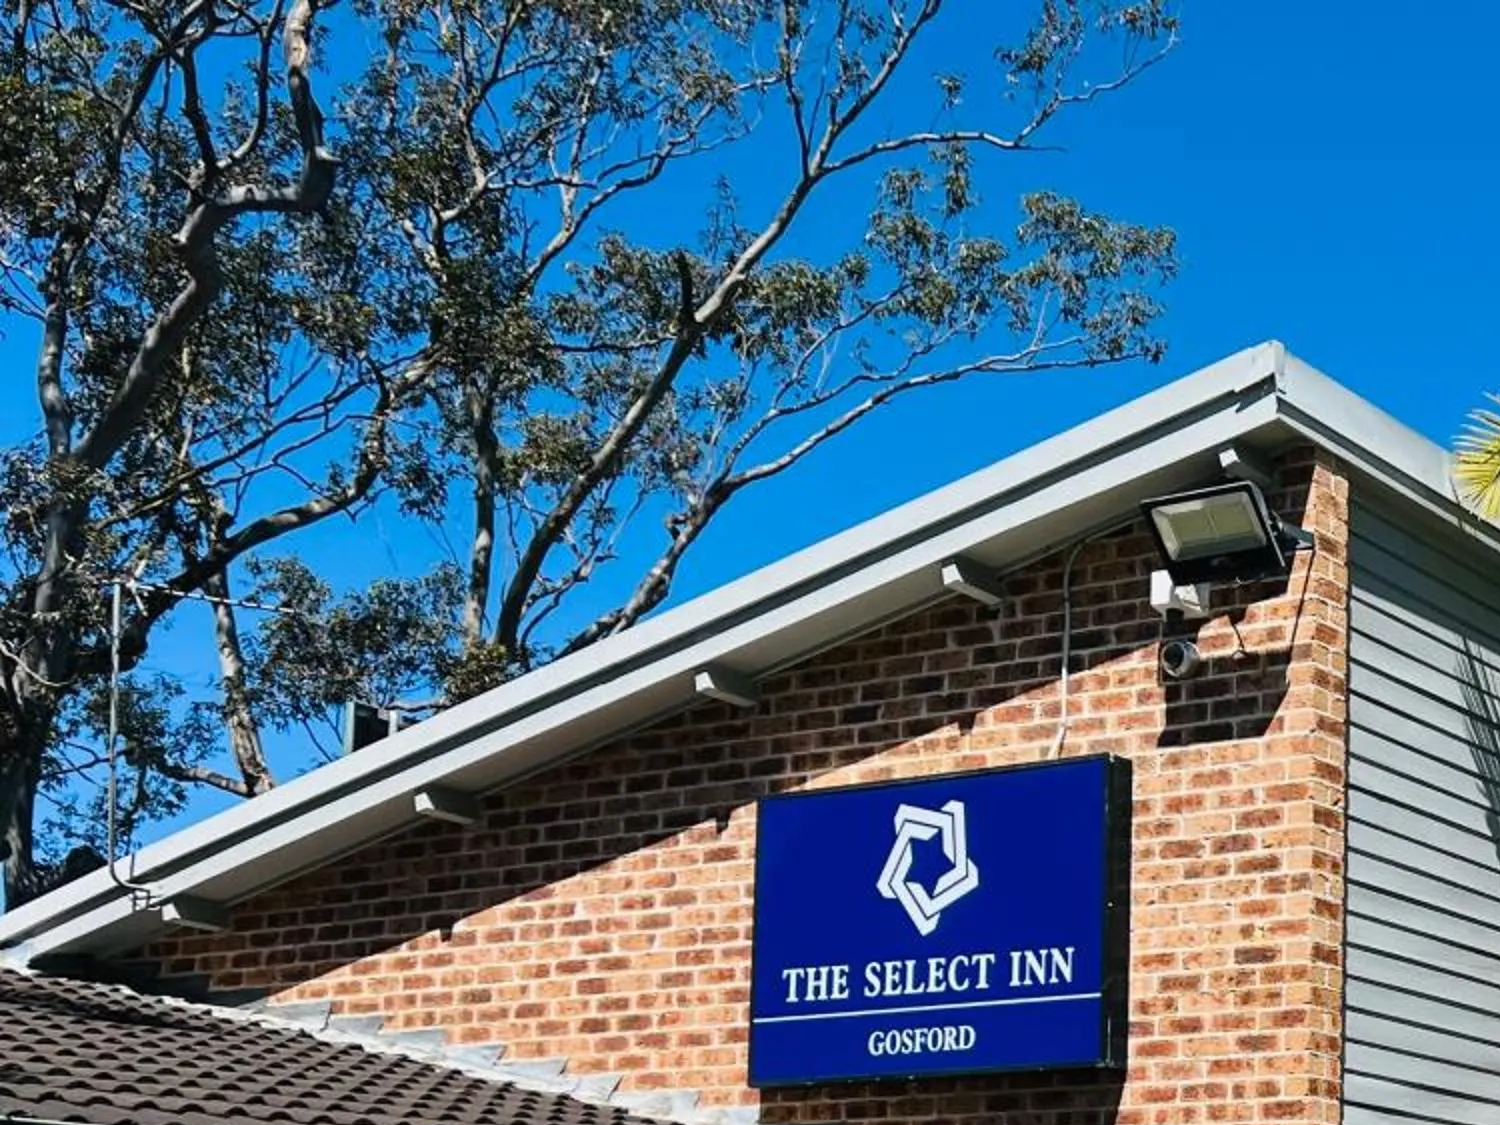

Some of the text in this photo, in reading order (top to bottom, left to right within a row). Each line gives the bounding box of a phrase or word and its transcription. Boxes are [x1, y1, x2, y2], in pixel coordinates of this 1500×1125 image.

[782, 947, 1075, 1003] THE SELECT INN
[868, 1025, 976, 1056] GOSFORD
